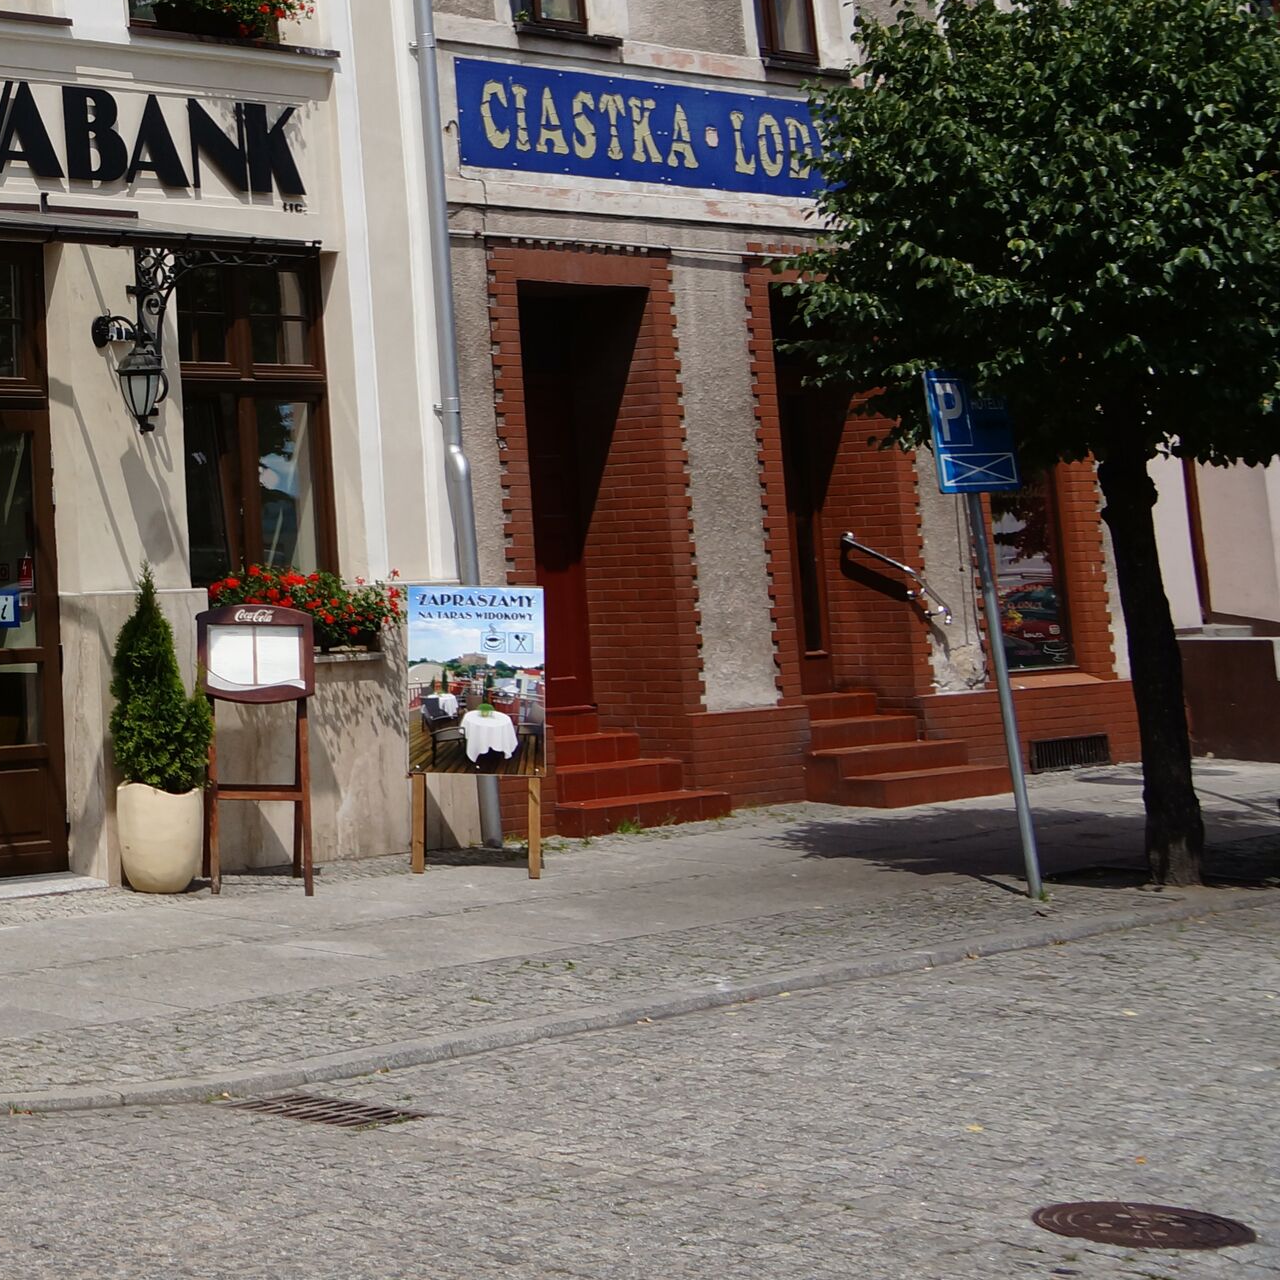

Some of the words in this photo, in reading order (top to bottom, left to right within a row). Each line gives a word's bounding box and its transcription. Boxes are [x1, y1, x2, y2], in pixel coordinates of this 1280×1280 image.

[480, 79, 699, 169] CIASTKA
[935, 383, 962, 441] P
[419, 593, 535, 608] ZAPRASZAMY
[419, 611, 433, 619] NA
[437, 612, 472, 620] TARAS
[475, 612, 533, 621] WIDOKOWY
